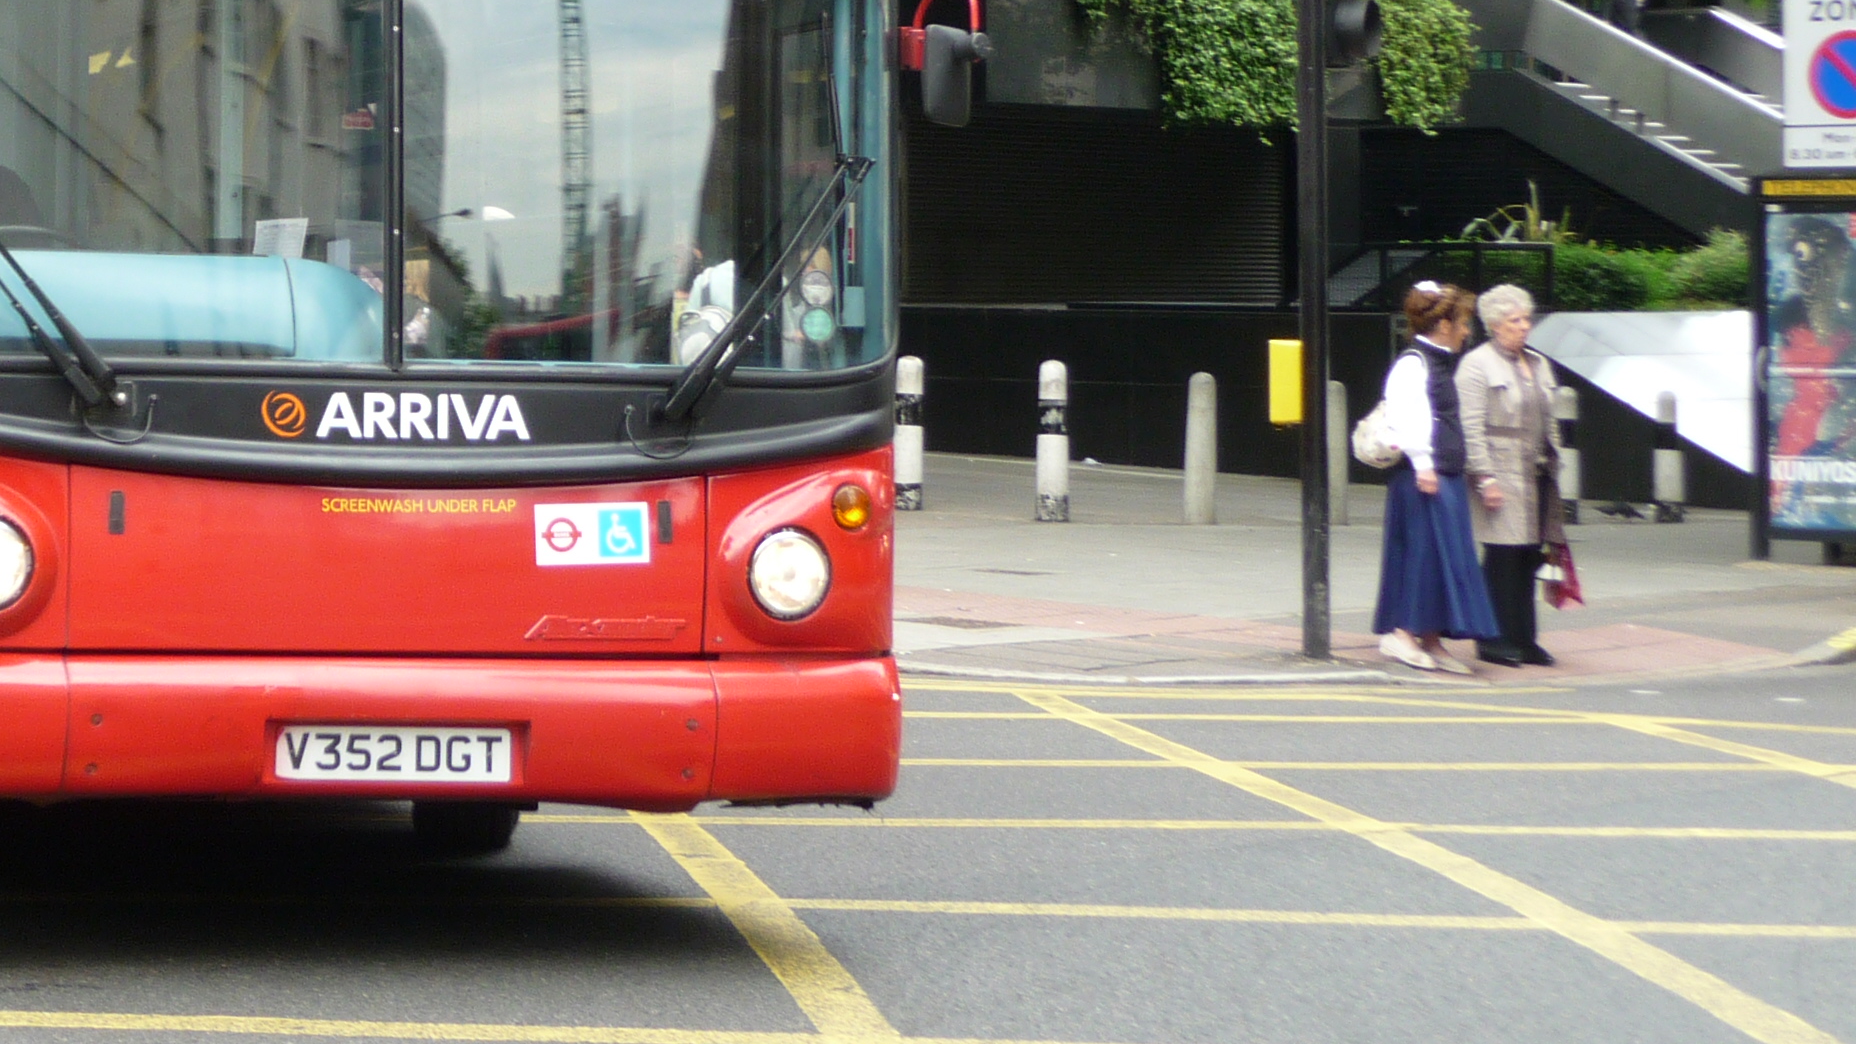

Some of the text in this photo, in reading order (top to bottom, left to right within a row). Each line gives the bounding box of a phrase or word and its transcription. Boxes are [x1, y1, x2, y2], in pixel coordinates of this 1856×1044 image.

[316, 392, 531, 440] ARRIVA
[321, 497, 516, 513] SCREENWASH UNDER FLAP
[285, 732, 502, 773] V352 DGT
